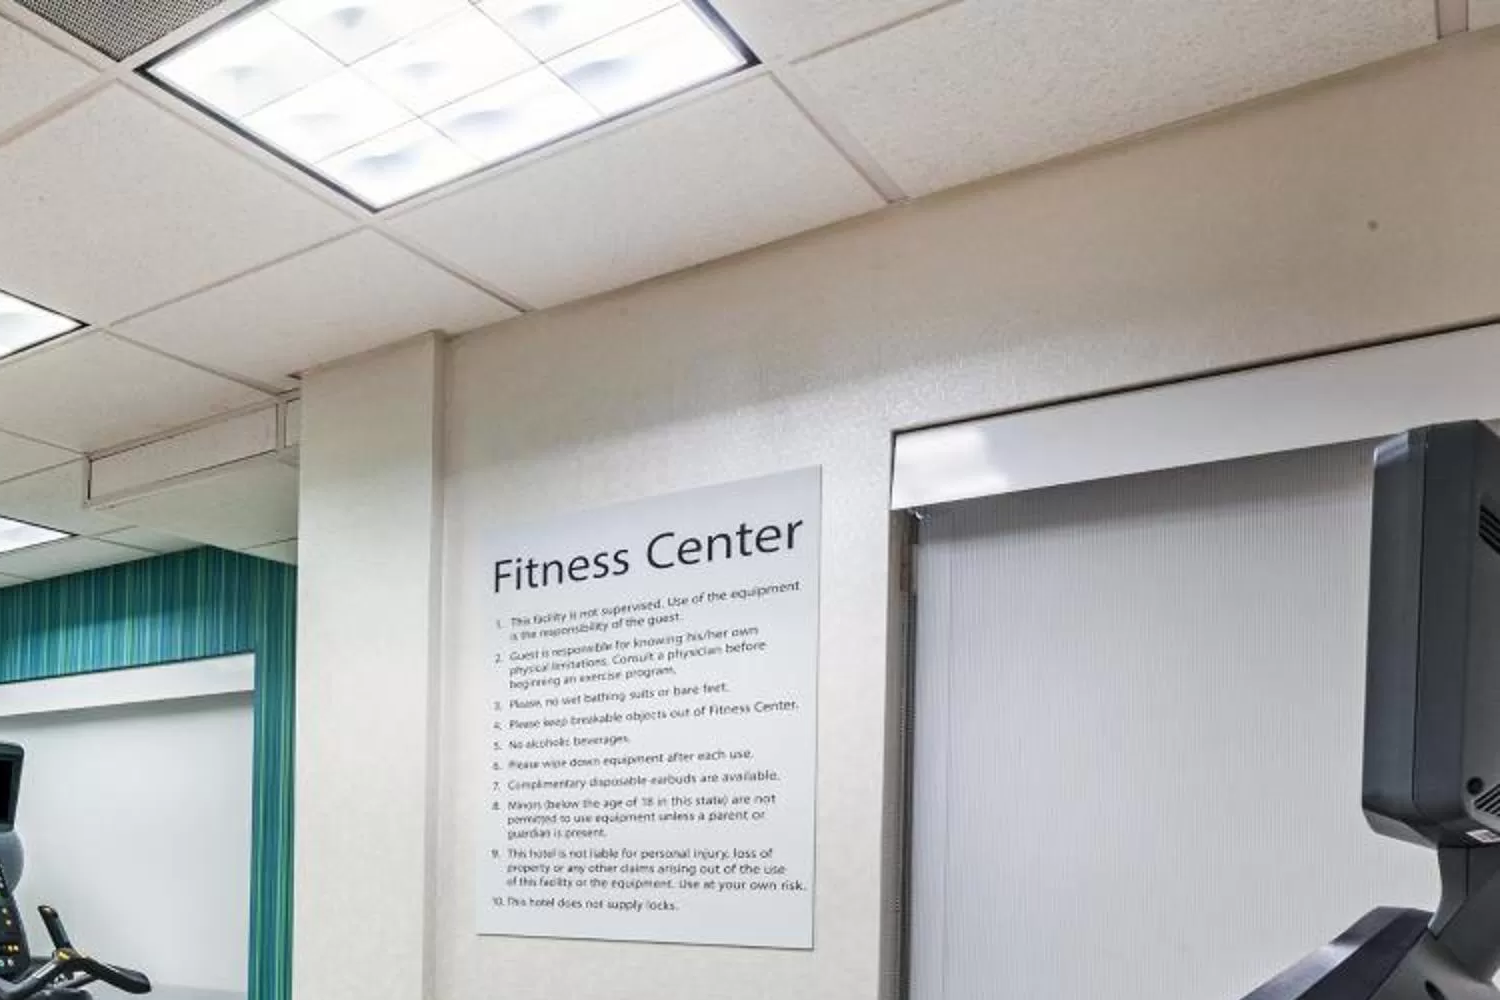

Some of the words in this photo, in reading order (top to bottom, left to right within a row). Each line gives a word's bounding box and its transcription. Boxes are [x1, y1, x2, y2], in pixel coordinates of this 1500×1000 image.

[494, 547, 629, 592] Fitness
[647, 520, 803, 569] Center
[511, 616, 529, 628] This
[533, 611, 566, 625] facility
[569, 609, 576, 620] is
[579, 606, 597, 619] not
[667, 595, 688, 607] Use
[691, 591, 704, 604] of
[707, 589, 727, 602] the
[730, 578, 799, 600] equipment
[510, 632, 518, 642] is
[520, 629, 536, 640] the
[539, 620, 607, 638] responsibility
[612, 617, 622, 629] of
[625, 616, 644, 627] the
[509, 649, 538, 662] Guest
[541, 648, 548, 658] is
[551, 641, 612, 657] responsible
[616, 639, 629, 650] for
[633, 633, 682, 648] knowing
[731, 625, 758, 637] own
[509, 663, 546, 678] physical
[612, 651, 653, 665] Consult
[657, 651, 664, 660] a
[667, 645, 722, 662] physician
[726, 640, 767, 653] before
[509, 676, 560, 691] beginning
[563, 675, 576, 685] an
[579, 670, 620, 683] exercise
[545, 698, 558, 707] no
[562, 694, 580, 706] wet
[584, 691, 625, 704] bathing
[629, 687, 654, 700] suits
[658, 688, 668, 697] or
[673, 685, 699, 696] bare
[509, 720, 540, 730] Please
[543, 717, 567, 729] keep
[570, 712, 622, 726] breakable
[625, 708, 666, 723] objects
[669, 706, 689, 718] out
[694, 705, 705, 716] of
[709, 703, 750, 715] Fitness
[754, 699, 798, 712] Center.
[509, 740, 521, 750] No
[525, 737, 569, 749] alcoholic
[508, 760, 538, 770] Please
[542, 758, 566, 770] wipe
[569, 757, 599, 767] down
[603, 752, 663, 767] equipment
[667, 751, 693, 762] after
[697, 748, 725, 761] each
[508, 778, 585, 792] Complimentary
[589, 774, 645, 789] disposable
[651, 772, 696, 785] earbuds
[700, 773, 718, 783] are
[508, 800, 541, 811] Minors
[583, 798, 599, 808] the
[604, 799, 622, 810] age
[626, 796, 636, 807] of
[657, 795, 666, 806] in
[671, 795, 692, 806] this
[732, 795, 750, 804] are
[754, 791, 776, 803] not
[507, 814, 556, 827] permitted
[559, 814, 570, 823] to
[574, 815, 591, 823] use
[595, 811, 655, 825] equipment
[659, 811, 694, 821] unless
[698, 812, 704, 820] a
[708, 809, 748, 823] parent
[751, 810, 764, 819] or
[507, 829, 550, 841] guardian
[553, 828, 560, 838] is
[508, 848, 525, 858] This
[529, 848, 555, 858] hotel
[558, 848, 565, 858] is
[569, 848, 586, 858] not
[590, 848, 618, 858] liable
[622, 848, 636, 858] for
[641, 847, 690, 860] personal
[733, 847, 755, 858] loss
[759, 847, 773, 858] of
[507, 863, 550, 875] property
[553, 865, 564, 873] or
[567, 865, 584, 875] any
[588, 863, 616, 873] other
[620, 863, 653, 874] claims
[657, 863, 696, 876] arising
[700, 863, 720, 874] out
[723, 863, 736, 874] of
[739, 863, 760, 874] the
[763, 866, 787, 874] use
[506, 877, 516, 886] of
[519, 877, 536, 887] this
[539, 877, 572, 889] facility
[575, 879, 586, 887] or
[589, 877, 608, 888] the
[679, 878, 700, 889] Use
[703, 878, 715, 889] at
[718, 881, 746, 892] your
[749, 881, 776, 890] own
[781, 879, 806, 890] risk.
[507, 897, 525, 907] This
[529, 897, 554, 907] hotel
[557, 898, 582, 908] does
[585, 898, 602, 909] not
[607, 899, 642, 912] supply
